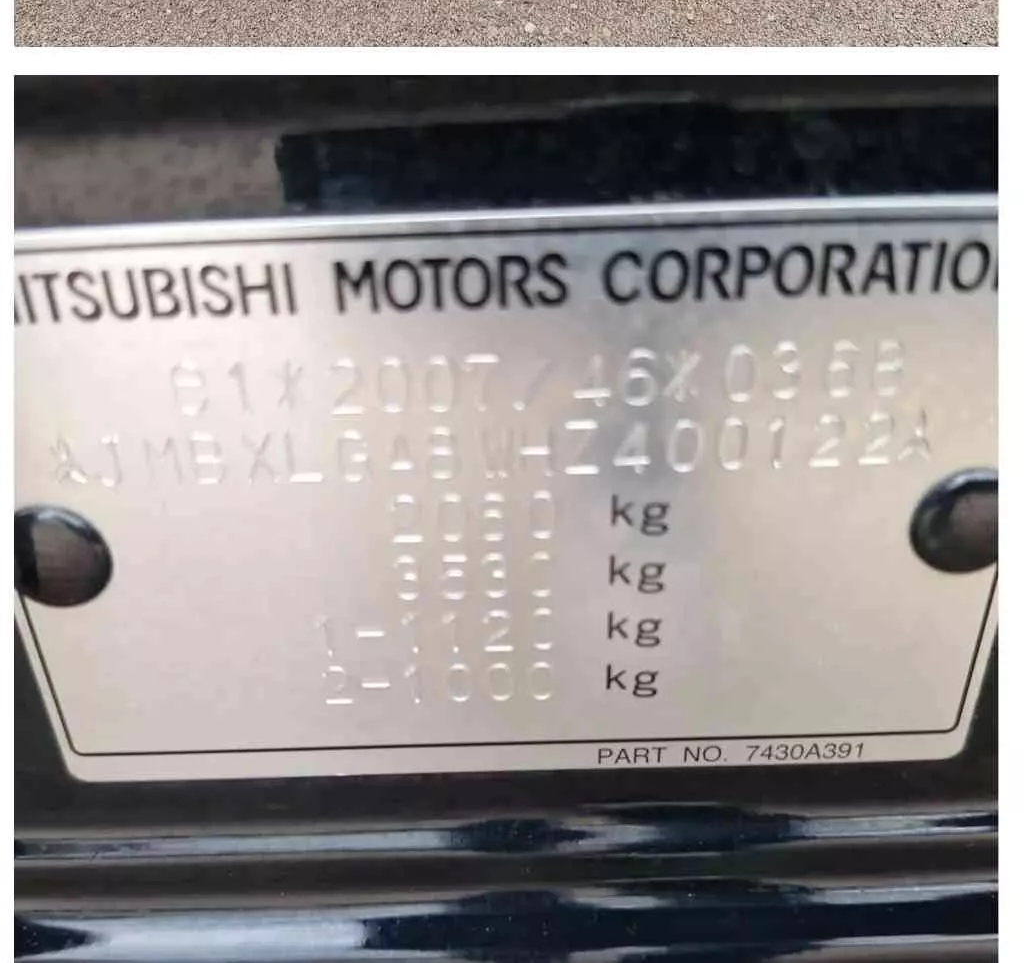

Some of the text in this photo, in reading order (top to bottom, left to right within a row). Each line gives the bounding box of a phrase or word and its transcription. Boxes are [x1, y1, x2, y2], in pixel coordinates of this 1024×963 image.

[14, 240, 999, 325] ITSUBISHI MOTORS CORPORATIO
[611, 495, 670, 537] kg
[609, 555, 667, 594] kg
[607, 611, 663, 648] kg
[605, 664, 659, 698] kg
[597, 742, 865, 765] PART NO. 7430A391
